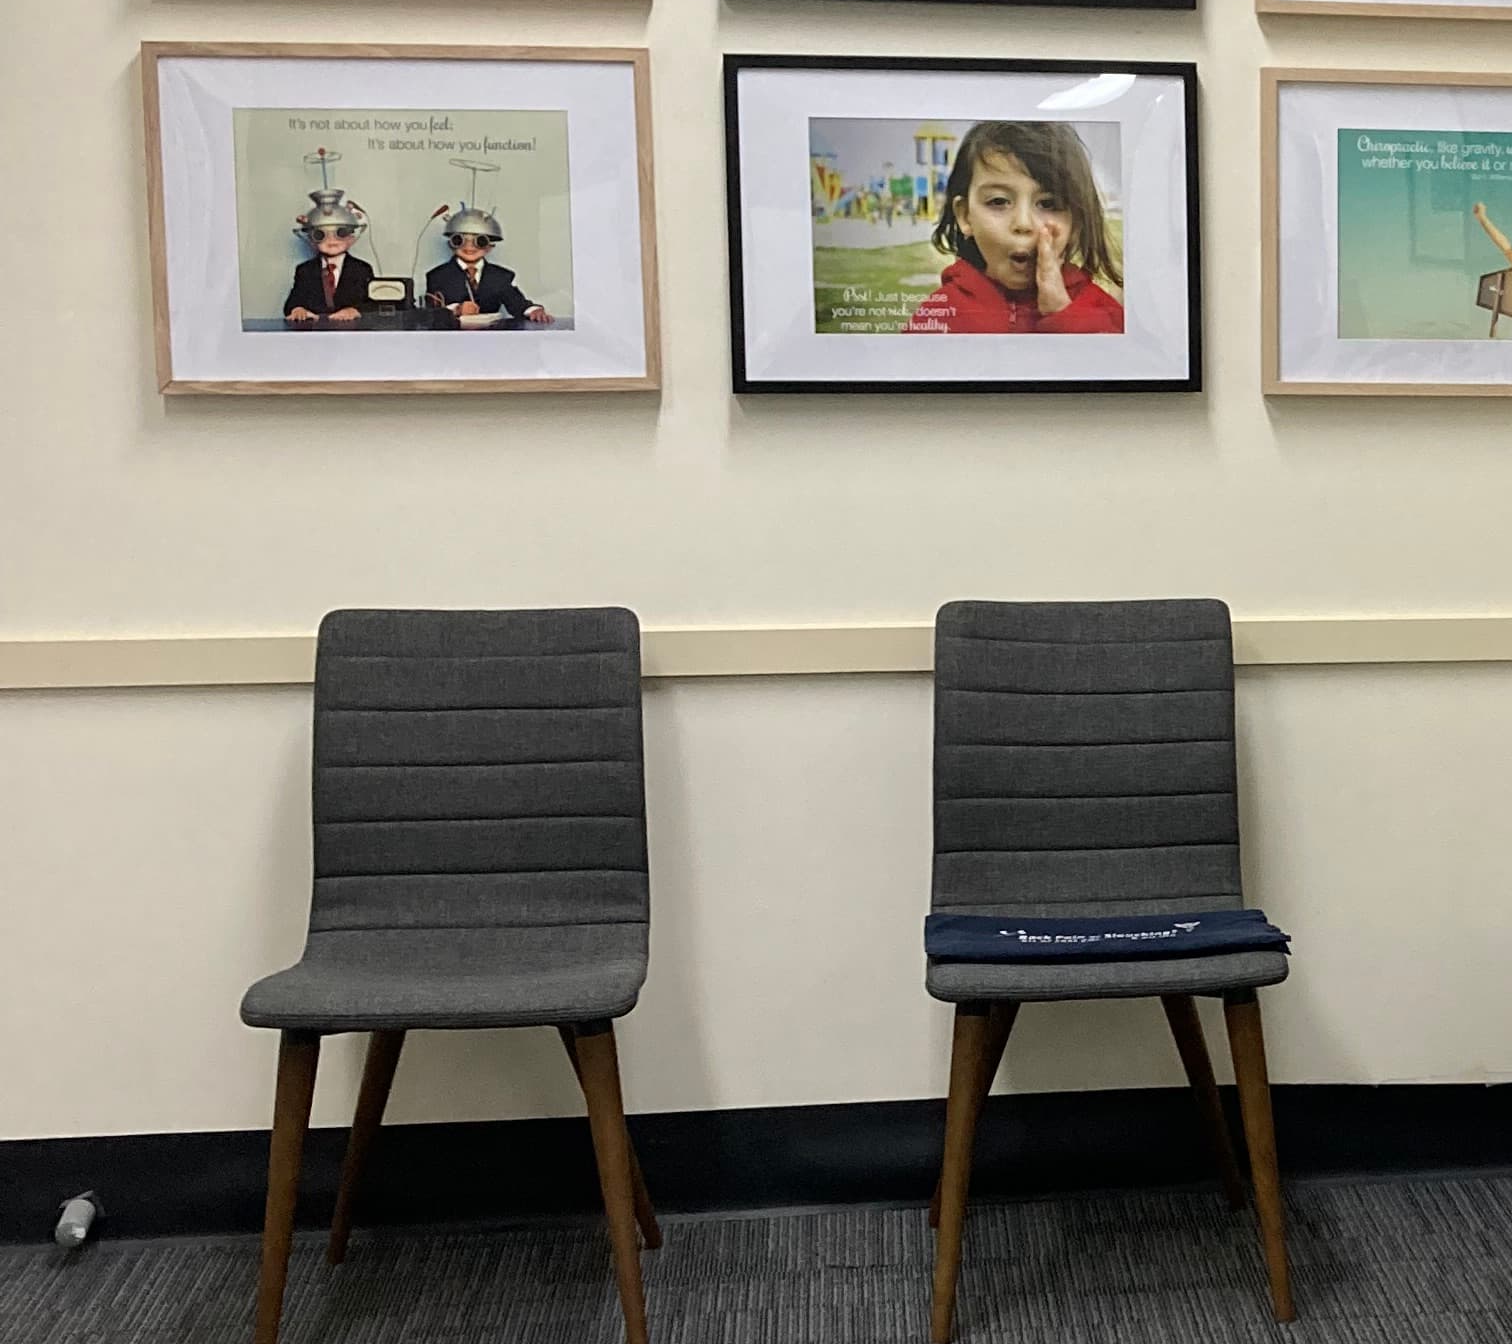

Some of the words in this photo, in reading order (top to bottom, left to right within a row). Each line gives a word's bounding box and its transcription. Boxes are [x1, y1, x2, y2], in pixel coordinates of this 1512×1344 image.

[289, 118, 306, 130] It's
[310, 119, 330, 131] not
[334, 119, 370, 131] about
[374, 119, 401, 131] how
[405, 122, 428, 133] you
[368, 138, 385, 150] It's
[389, 138, 425, 151] about
[428, 139, 455, 151] how
[458, 141, 482, 153] you
[483, 136, 537, 154] function!
[1437, 141, 1458, 154] like
[1362, 156, 1413, 169] whether
[1416, 159, 1439, 172] you
[1440, 155, 1479, 170] believe
[1481, 157, 1490, 170] it
[1493, 161, 1507, 171] or
[875, 291, 898, 303] Just
[901, 292, 948, 303] because
[832, 306, 866, 319] you're
[868, 308, 887, 317] not
[915, 306, 957, 317] doesn't
[841, 321, 872, 331] mean
[874, 320, 907, 333] you're
